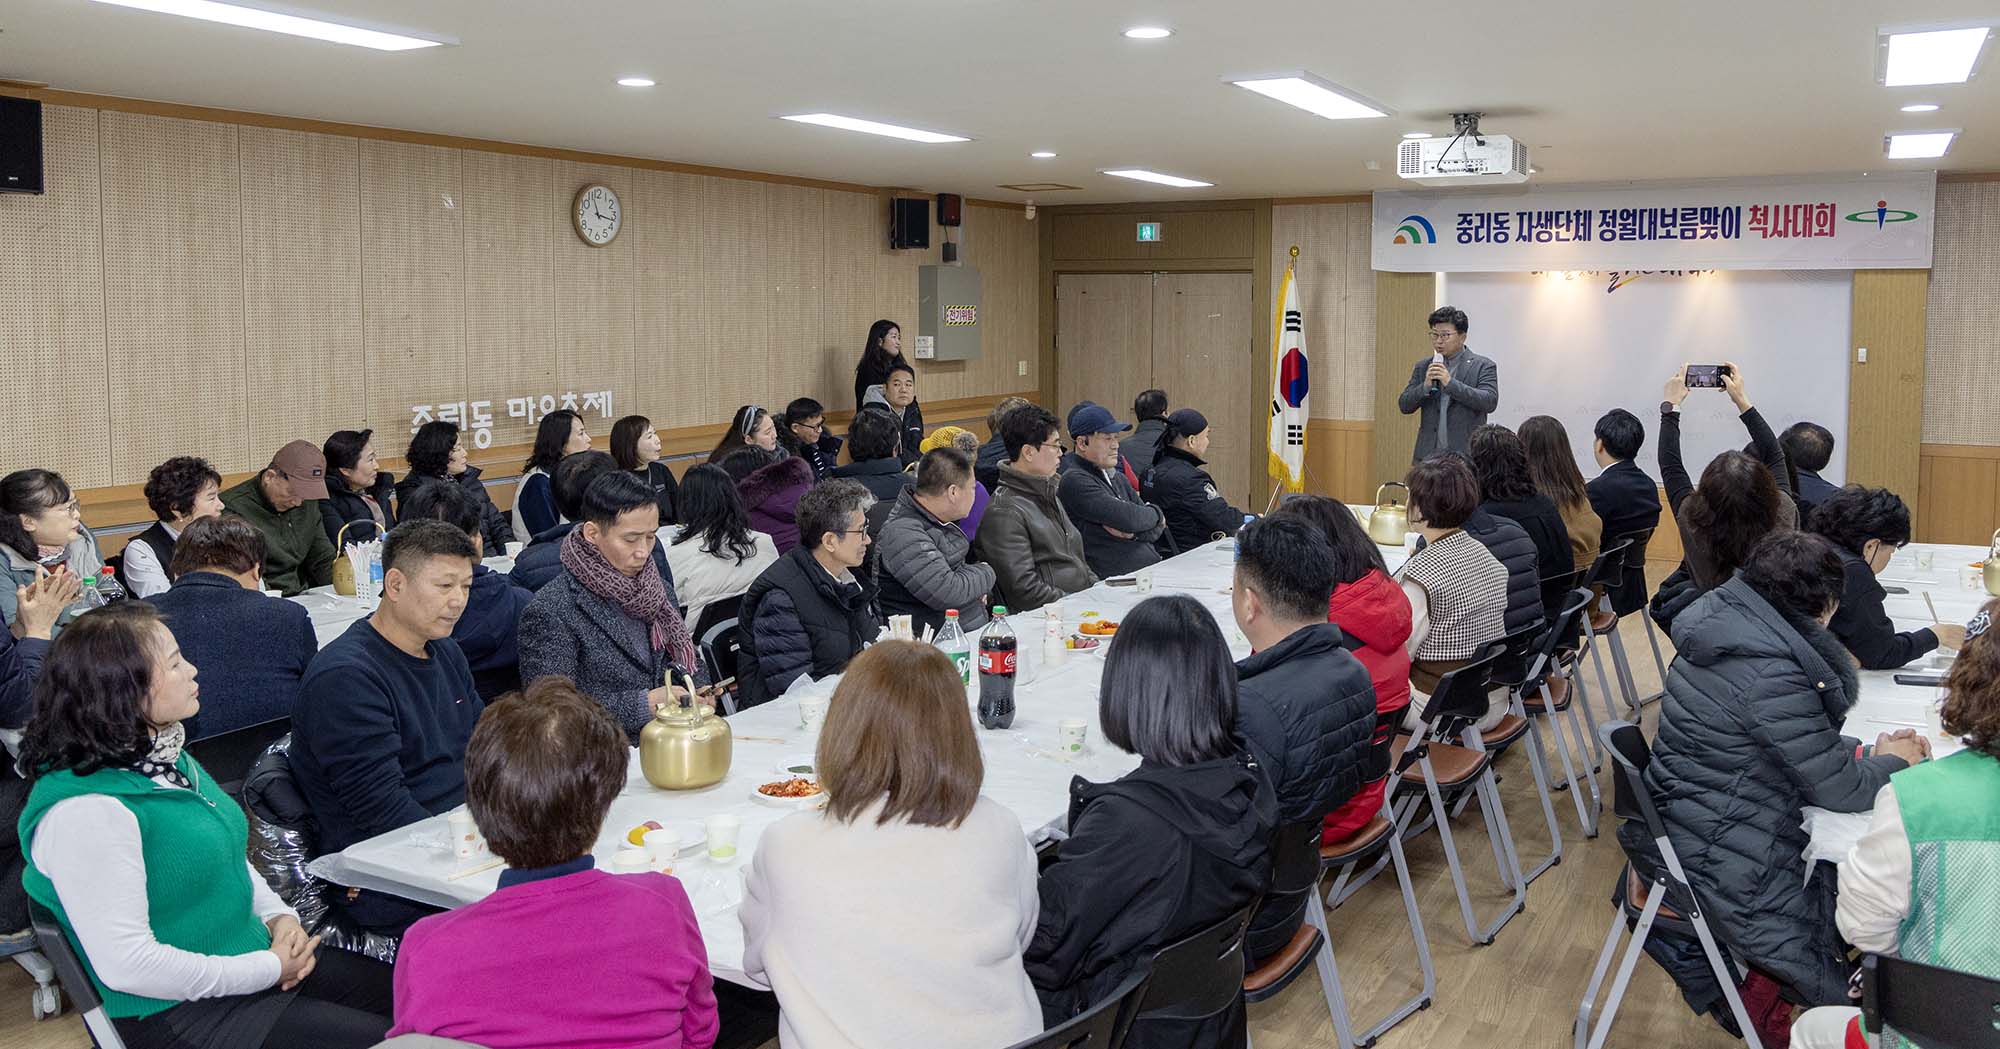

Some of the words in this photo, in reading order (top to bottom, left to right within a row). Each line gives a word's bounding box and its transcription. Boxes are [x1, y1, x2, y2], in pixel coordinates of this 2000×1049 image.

[594, 188, 602, 199] 12
[608, 199, 614, 210] 2
[611, 210, 617, 222] 3
[581, 220, 587, 229] 8
[1456, 211, 1511, 245] 중리동
[1515, 208, 1592, 244] 자생단체
[1598, 205, 1742, 242] 정월대보름맞이
[1748, 202, 1836, 240] 척사대회
[588, 228, 593, 237] 7
[594, 232, 600, 240] 6
[602, 229, 608, 238] 5
[949, 309, 974, 321] 전기위험
